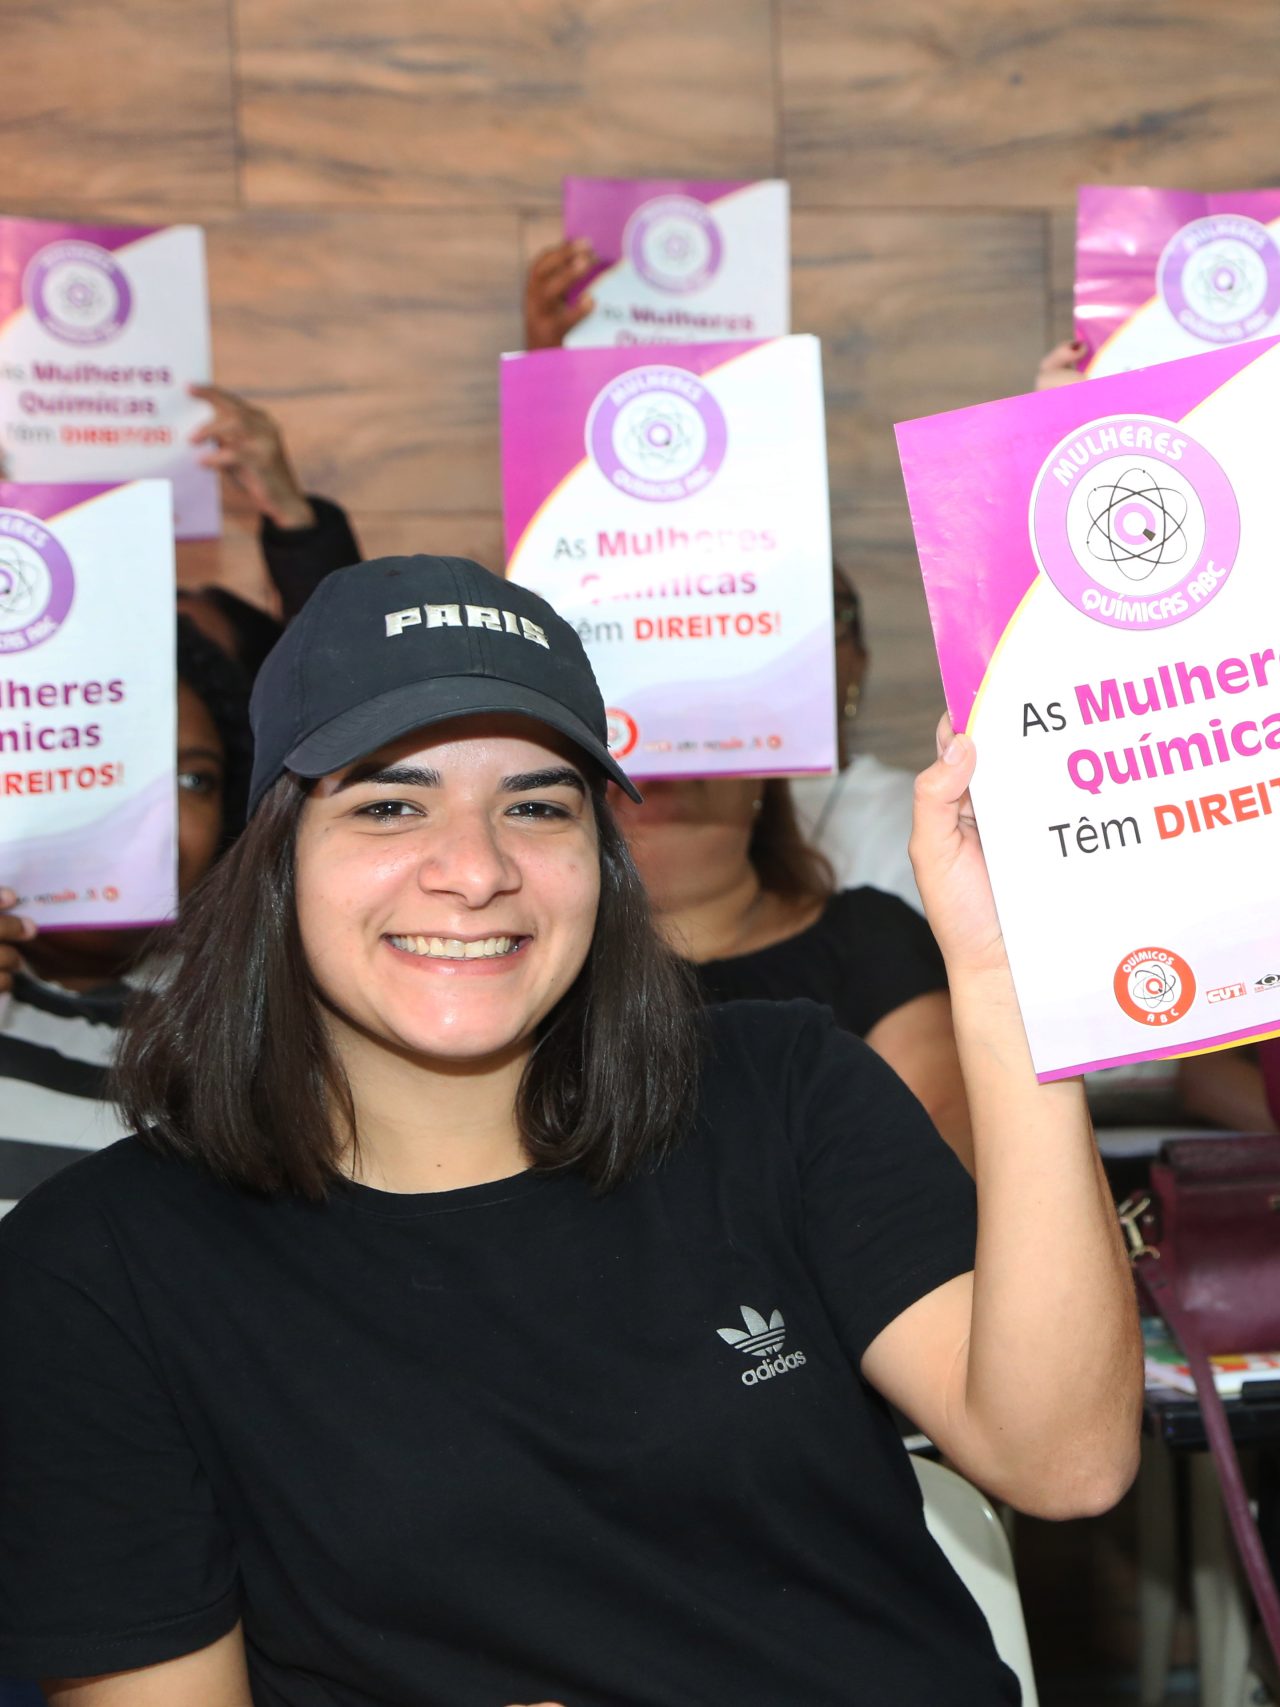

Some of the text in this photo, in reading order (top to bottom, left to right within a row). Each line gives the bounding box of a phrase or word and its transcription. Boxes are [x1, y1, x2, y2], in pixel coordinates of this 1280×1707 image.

[1052, 426, 1188, 487] MULHERES
[554, 527, 777, 560] As Mulheres
[1081, 560, 1226, 623] QUÍMICAS ABC
[385, 603, 550, 649] PARIS
[572, 609, 782, 643] êm DIREITOS!
[0, 678, 125, 709] heres
[1021, 702, 1067, 737] As
[0, 762, 125, 795] REITOS!
[1049, 816, 1142, 858] Têm
[1122, 950, 1175, 973] QUÍMICOS
[1206, 984, 1243, 1003] CUT
[741, 1350, 807, 1386] adidas
